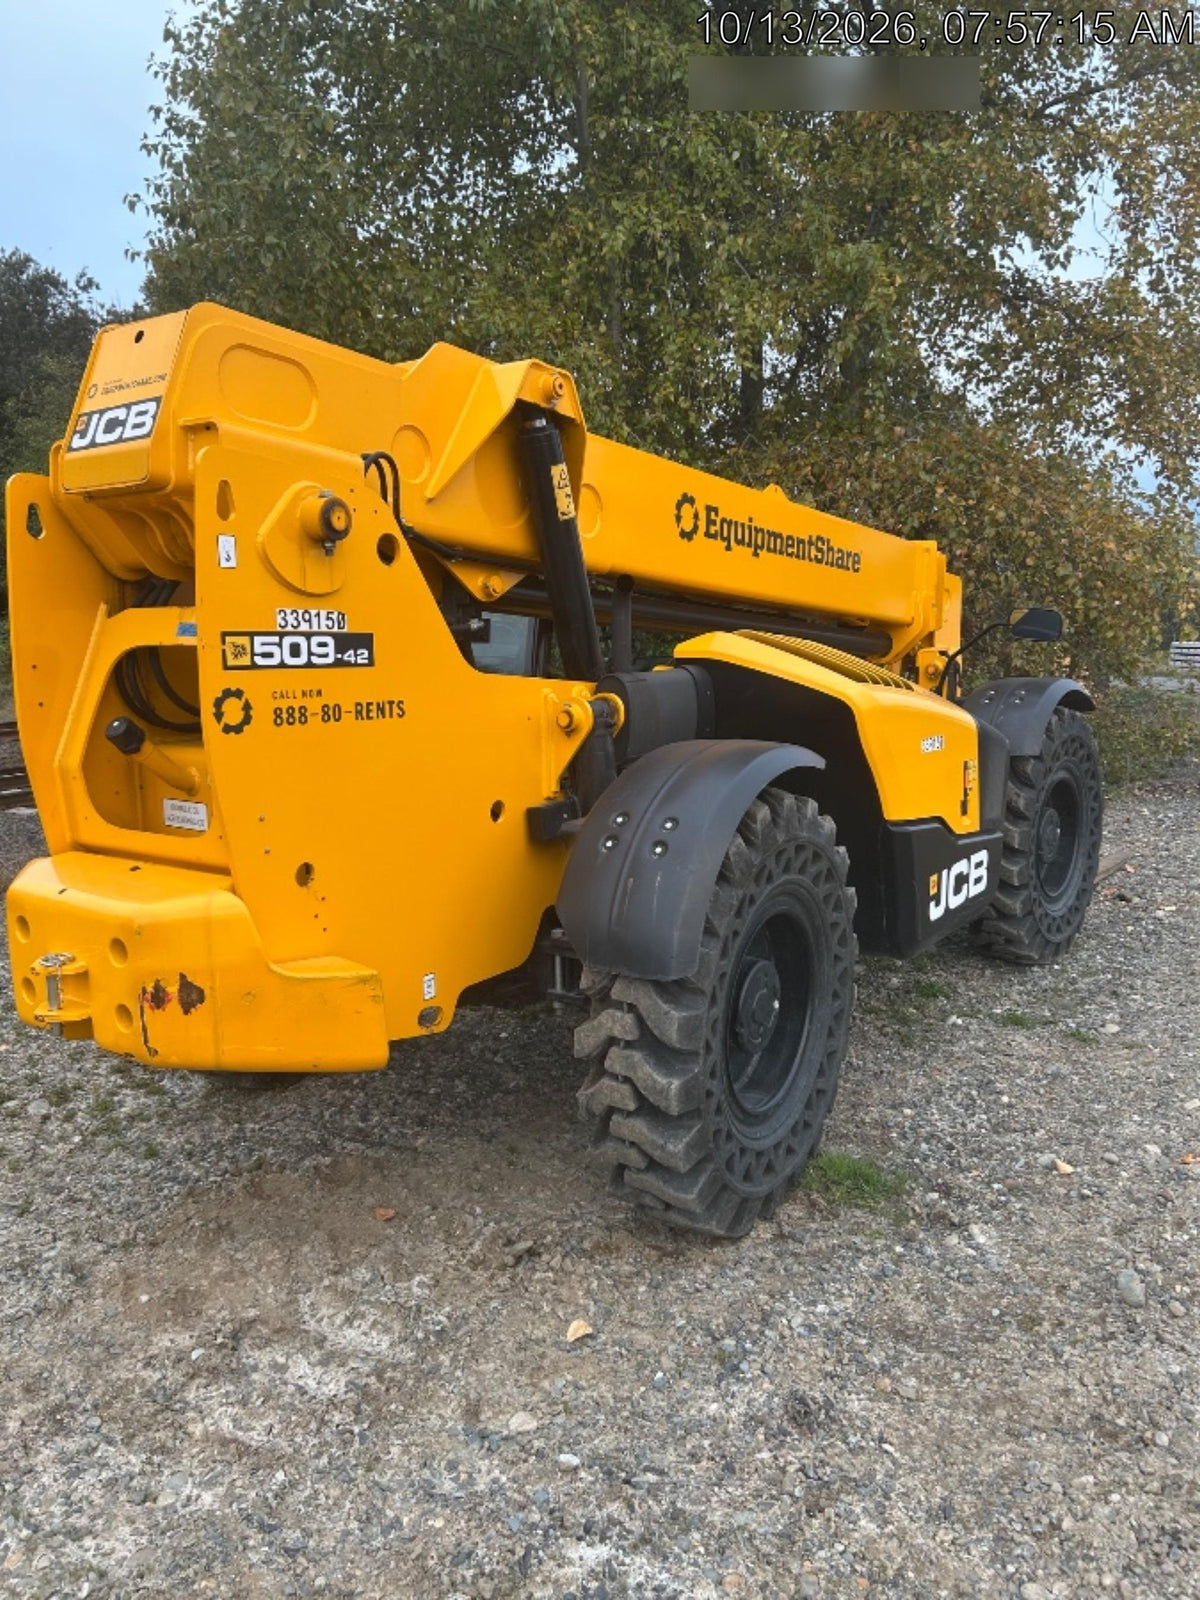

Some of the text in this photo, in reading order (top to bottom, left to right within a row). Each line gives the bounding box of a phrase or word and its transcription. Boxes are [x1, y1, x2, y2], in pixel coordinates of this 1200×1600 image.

[71, 401, 158, 449] JCB
[703, 504, 862, 573] EquipmentShare
[277, 609, 346, 630] 339150
[253, 635, 369, 666] 509-42
[272, 689, 323, 700] CALL NOW
[272, 700, 406, 727] 888-80-RENTS
[929, 848, 989, 922] JCB
